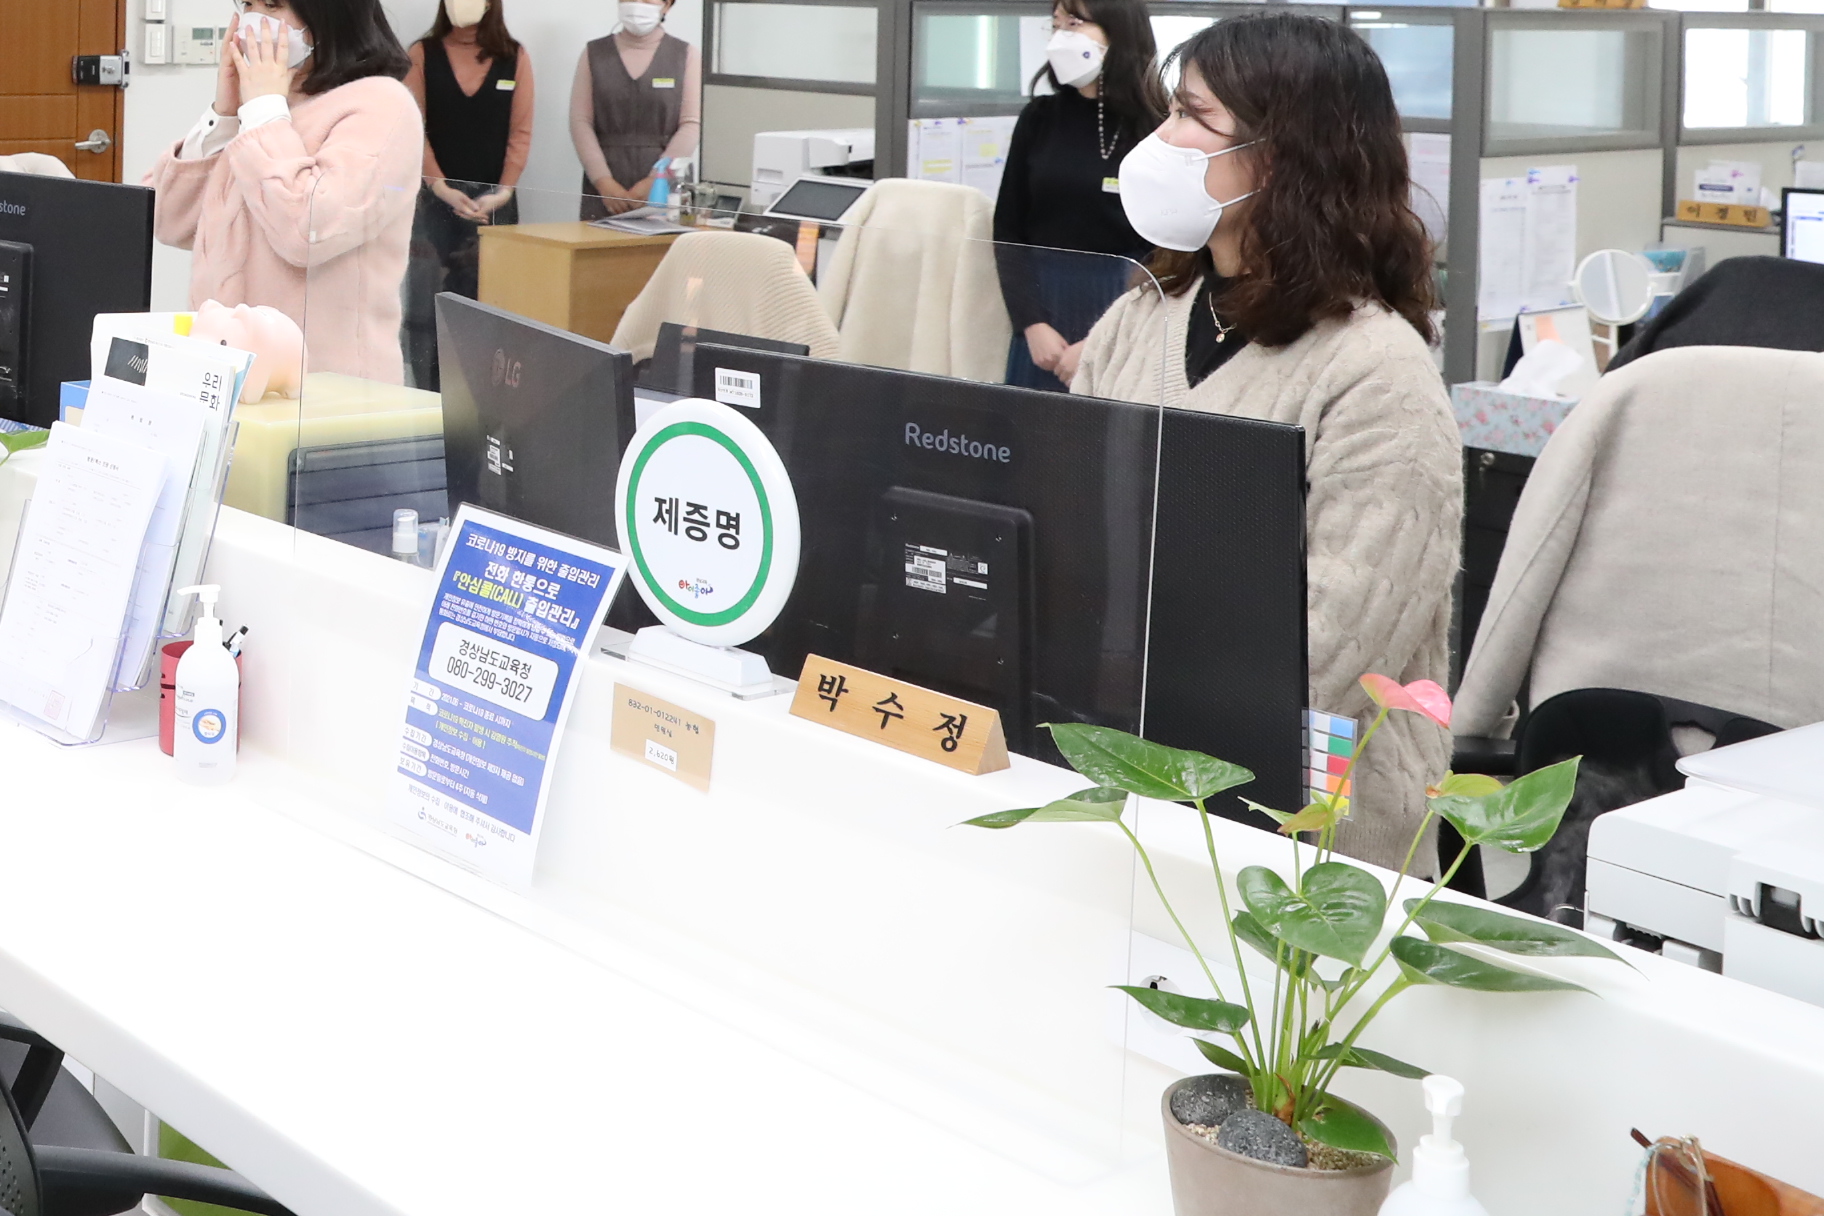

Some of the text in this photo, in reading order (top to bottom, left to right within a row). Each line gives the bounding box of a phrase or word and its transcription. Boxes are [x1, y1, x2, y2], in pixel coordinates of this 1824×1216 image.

[202, 372, 222, 391] 우리
[505, 358, 522, 388] LG
[905, 421, 1011, 464] Redstone
[652, 495, 742, 551] 제증명
[466, 532, 600, 588] 코로나19 방지를 위한 출입관리
[484, 561, 560, 601] 전화 한통으로
[446, 656, 532, 703] 080-299-3027
[458, 639, 531, 679] 경상남도교육청
